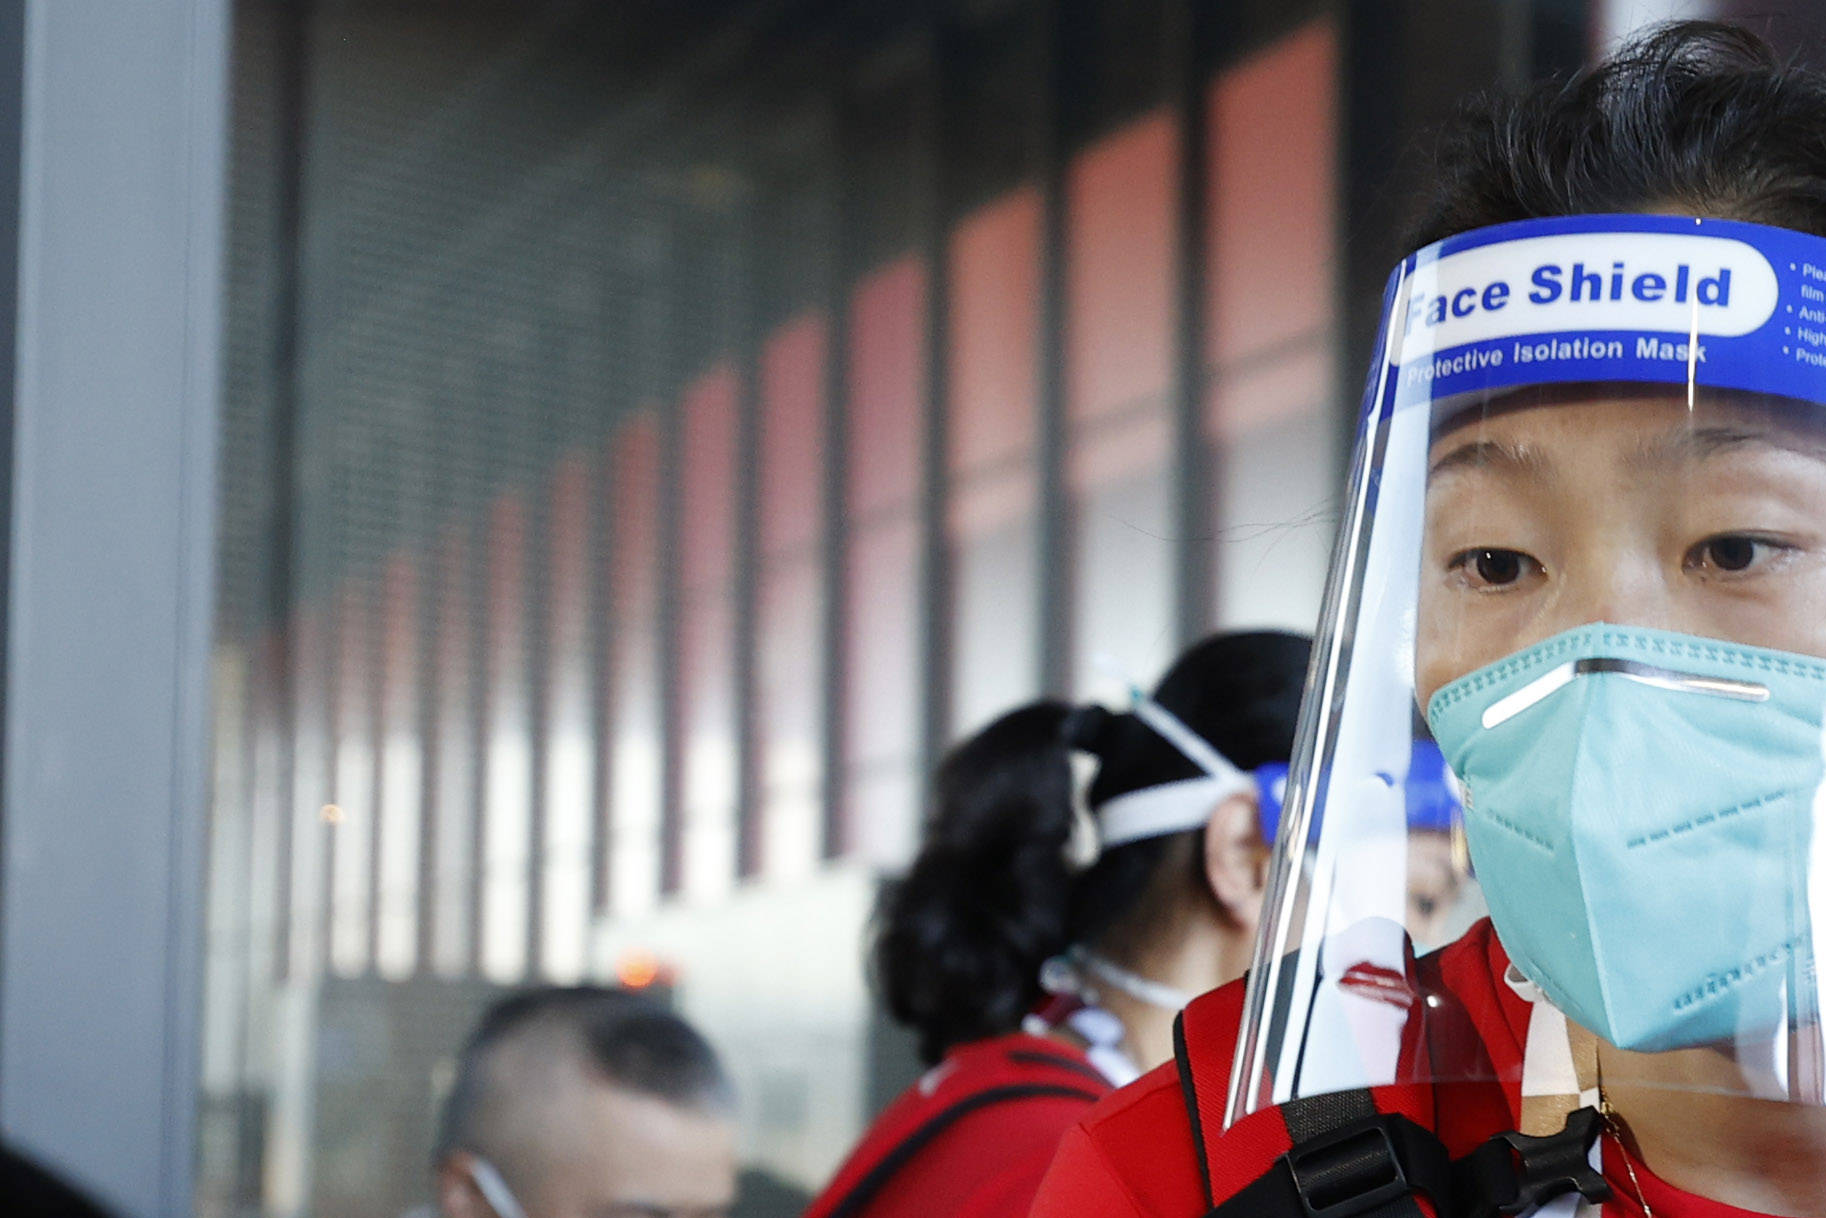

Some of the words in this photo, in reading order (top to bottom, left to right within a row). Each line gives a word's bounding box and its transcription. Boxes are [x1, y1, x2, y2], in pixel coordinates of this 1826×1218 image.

[1405, 281, 1511, 336] Face
[1528, 261, 1732, 308] Shield
[1801, 284, 1824, 303] film
[1406, 345, 1504, 387] Protective
[1514, 337, 1623, 364] Isolation
[1636, 337, 1707, 363] Mask
